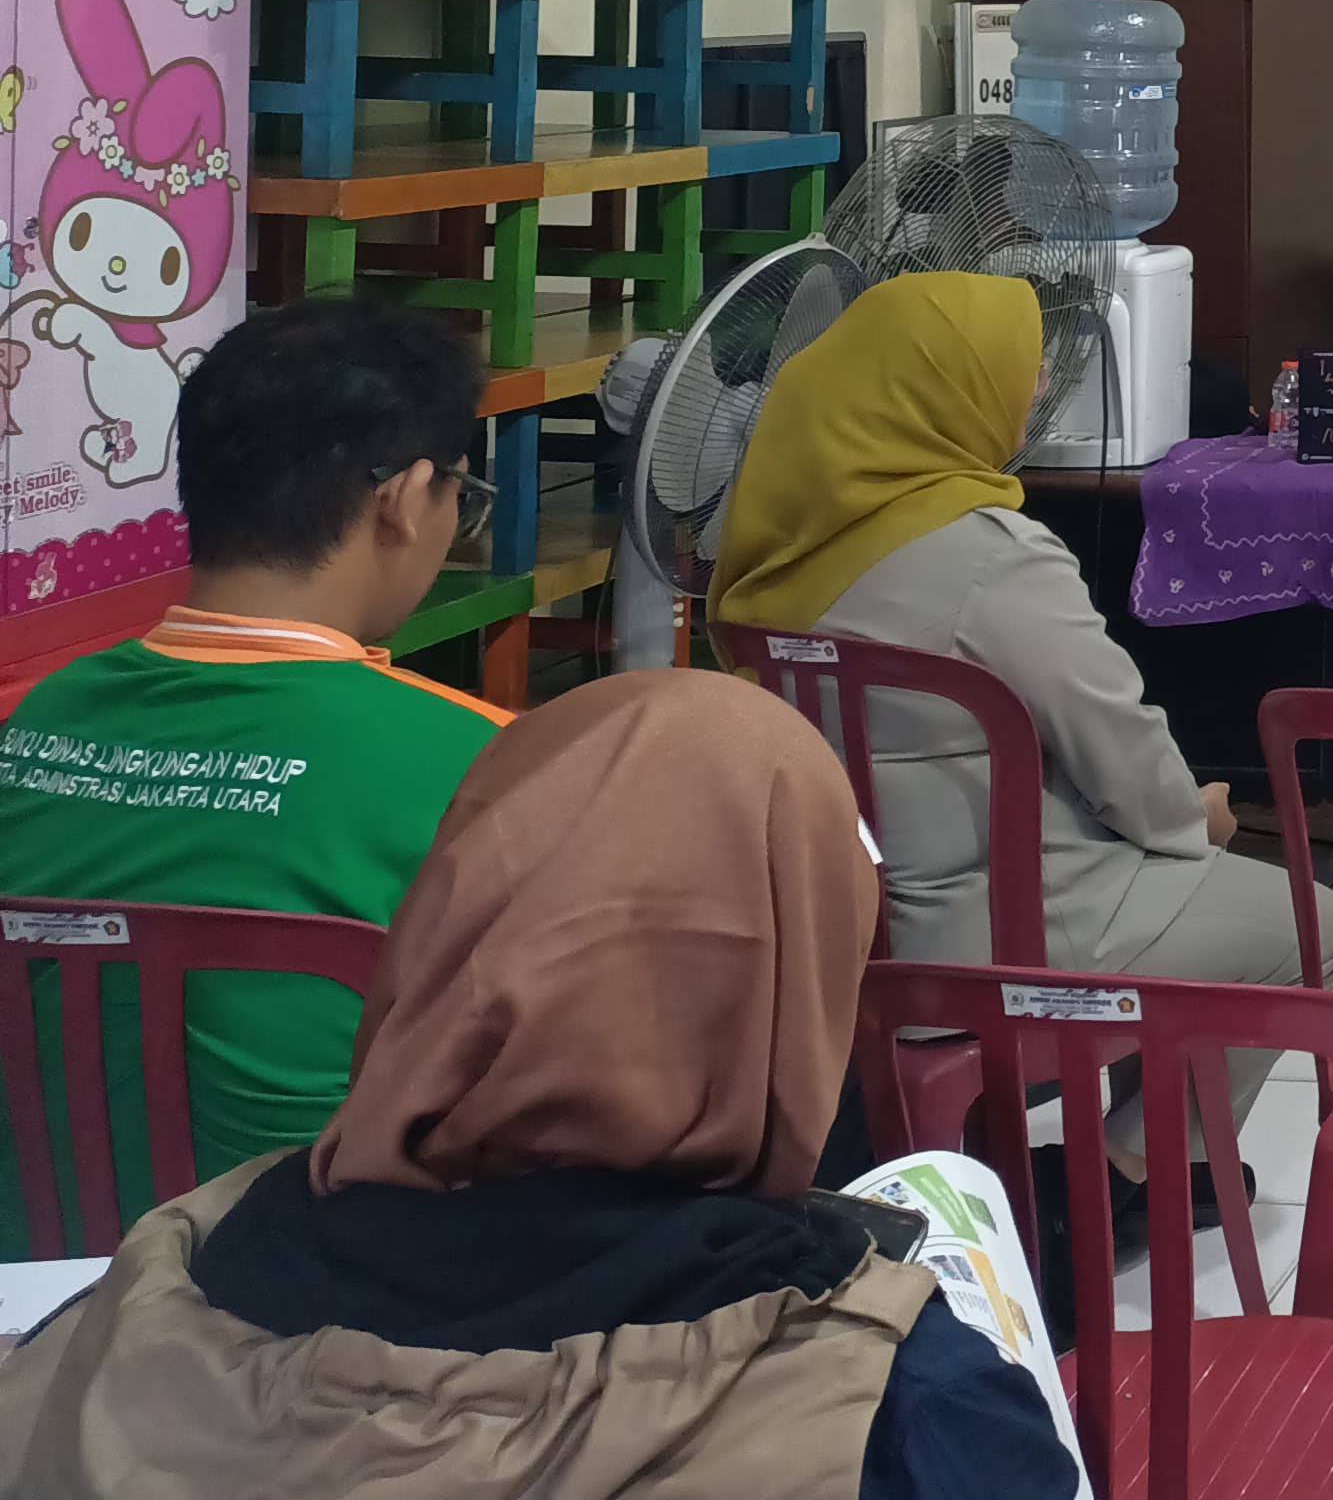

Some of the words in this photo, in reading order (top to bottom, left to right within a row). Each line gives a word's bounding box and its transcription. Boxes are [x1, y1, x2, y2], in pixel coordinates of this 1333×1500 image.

[979, 77, 1013, 103] 048
[39, 735, 97, 766] DINAS
[94, 744, 233, 779] LINGKUNGAN
[231, 752, 307, 785] HIDUP
[126, 783, 210, 809] JAKARTA
[213, 787, 281, 817] UTARA
